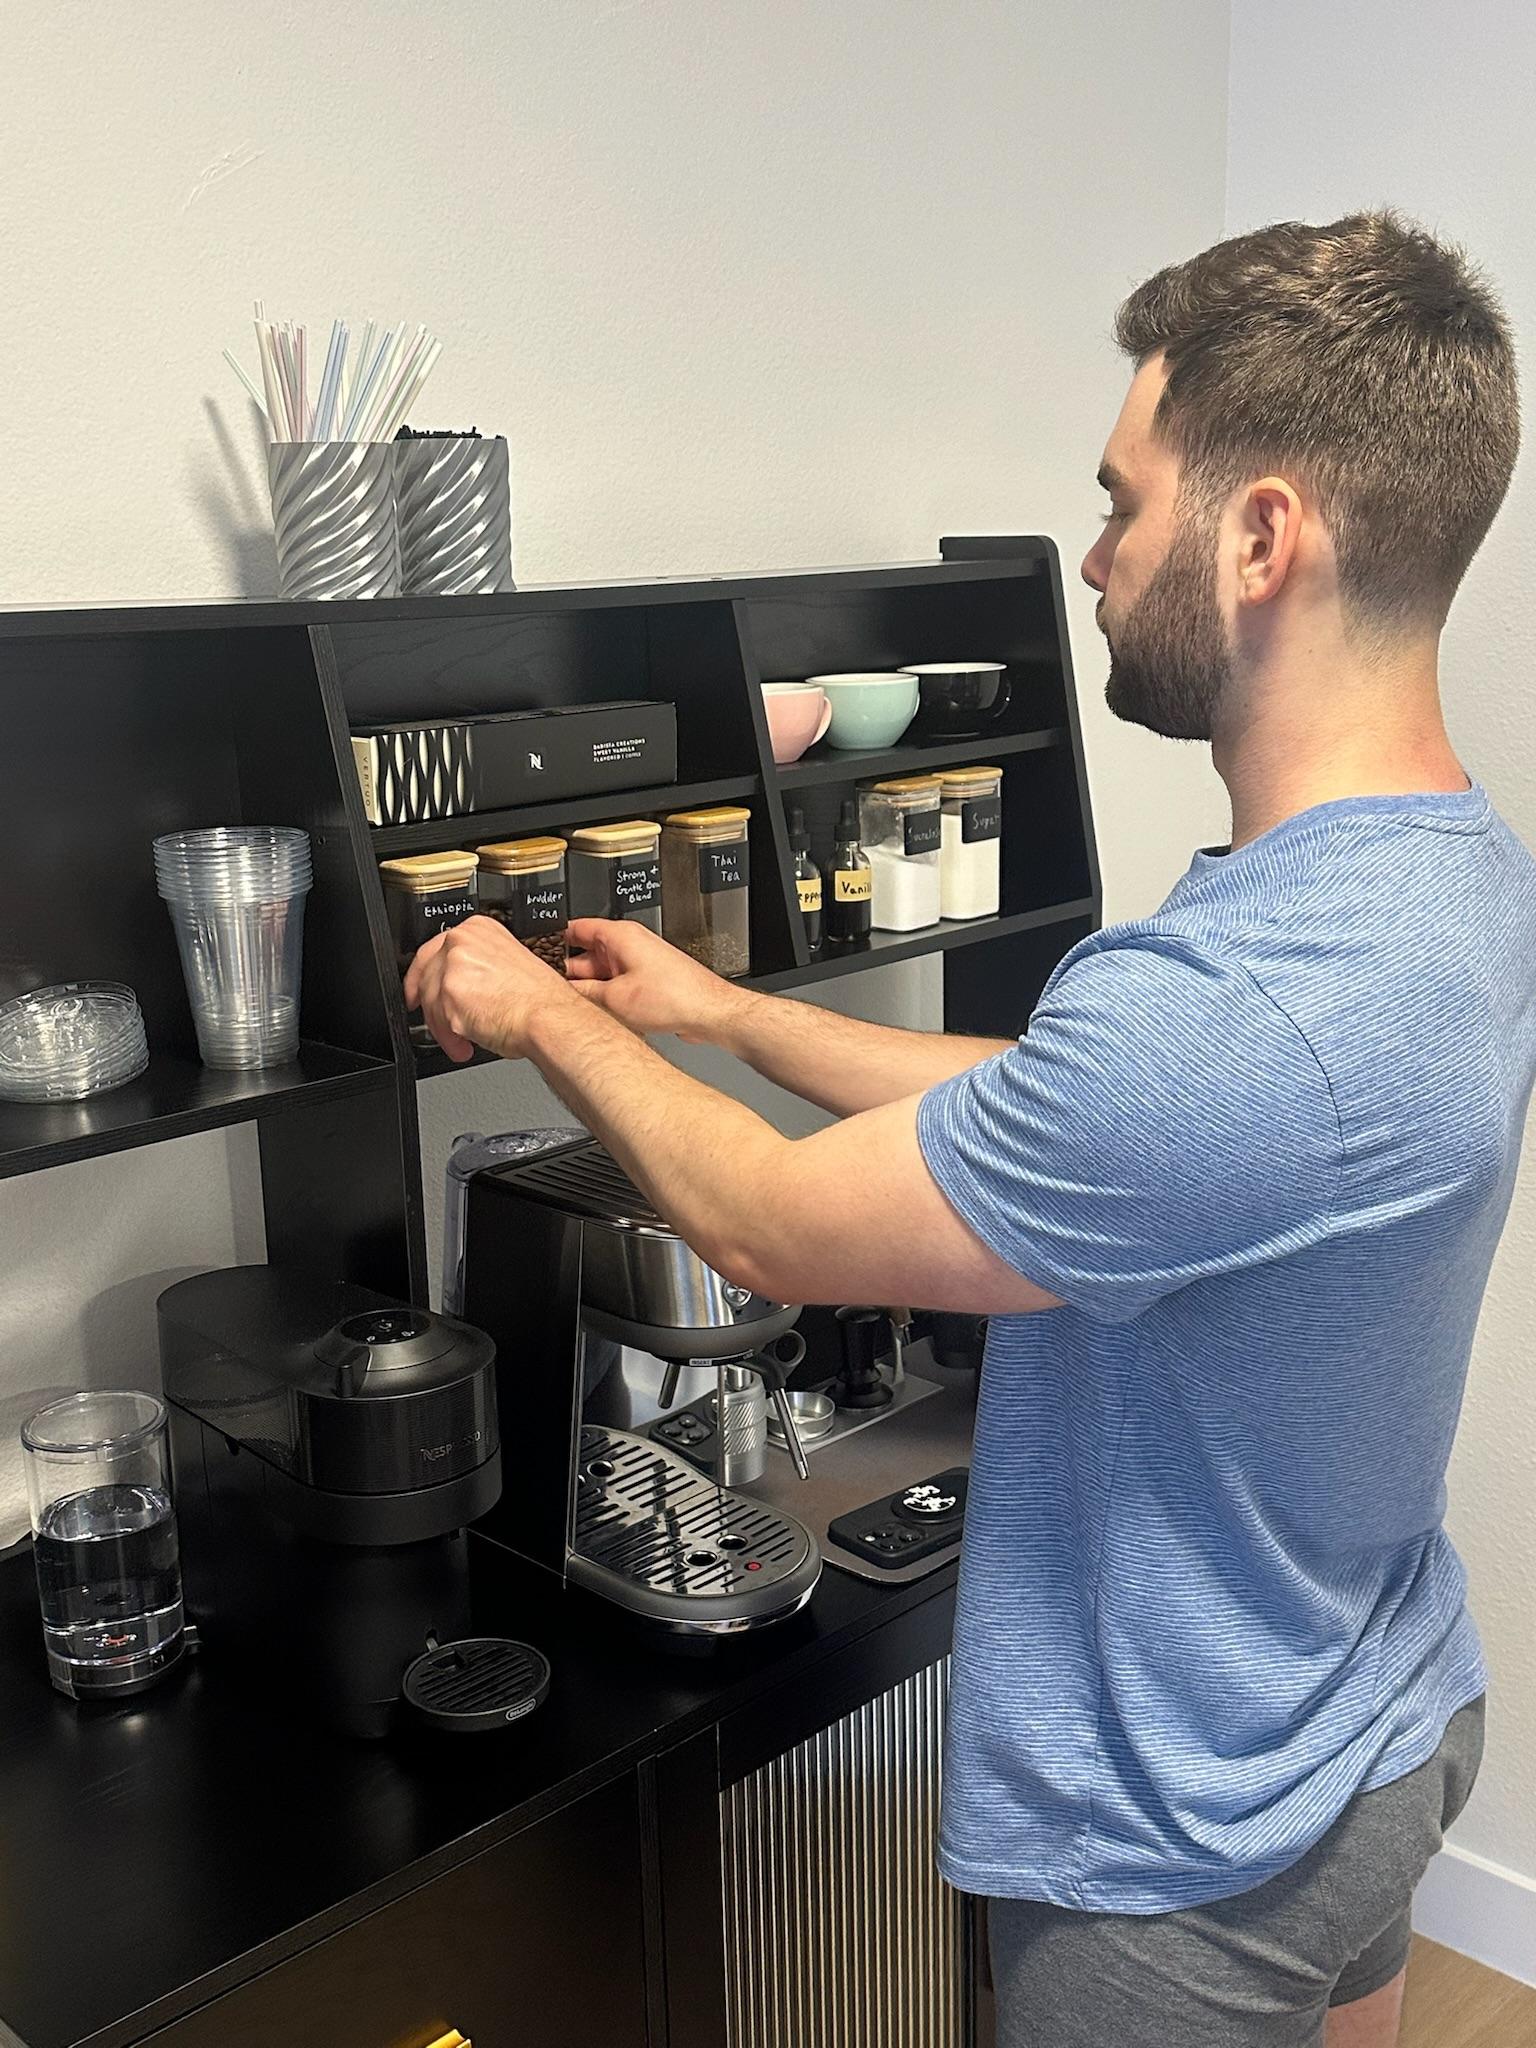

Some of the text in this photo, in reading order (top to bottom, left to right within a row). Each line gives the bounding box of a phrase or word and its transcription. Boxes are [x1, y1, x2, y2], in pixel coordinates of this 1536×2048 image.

[362, 756, 371, 807] VERTUO
[711, 850, 737, 867] Thai
[616, 870, 647, 883] Strong
[616, 883, 643, 895] Gentle
[629, 890, 652, 903] Blend
[424, 899, 475, 918] Ethiopia
